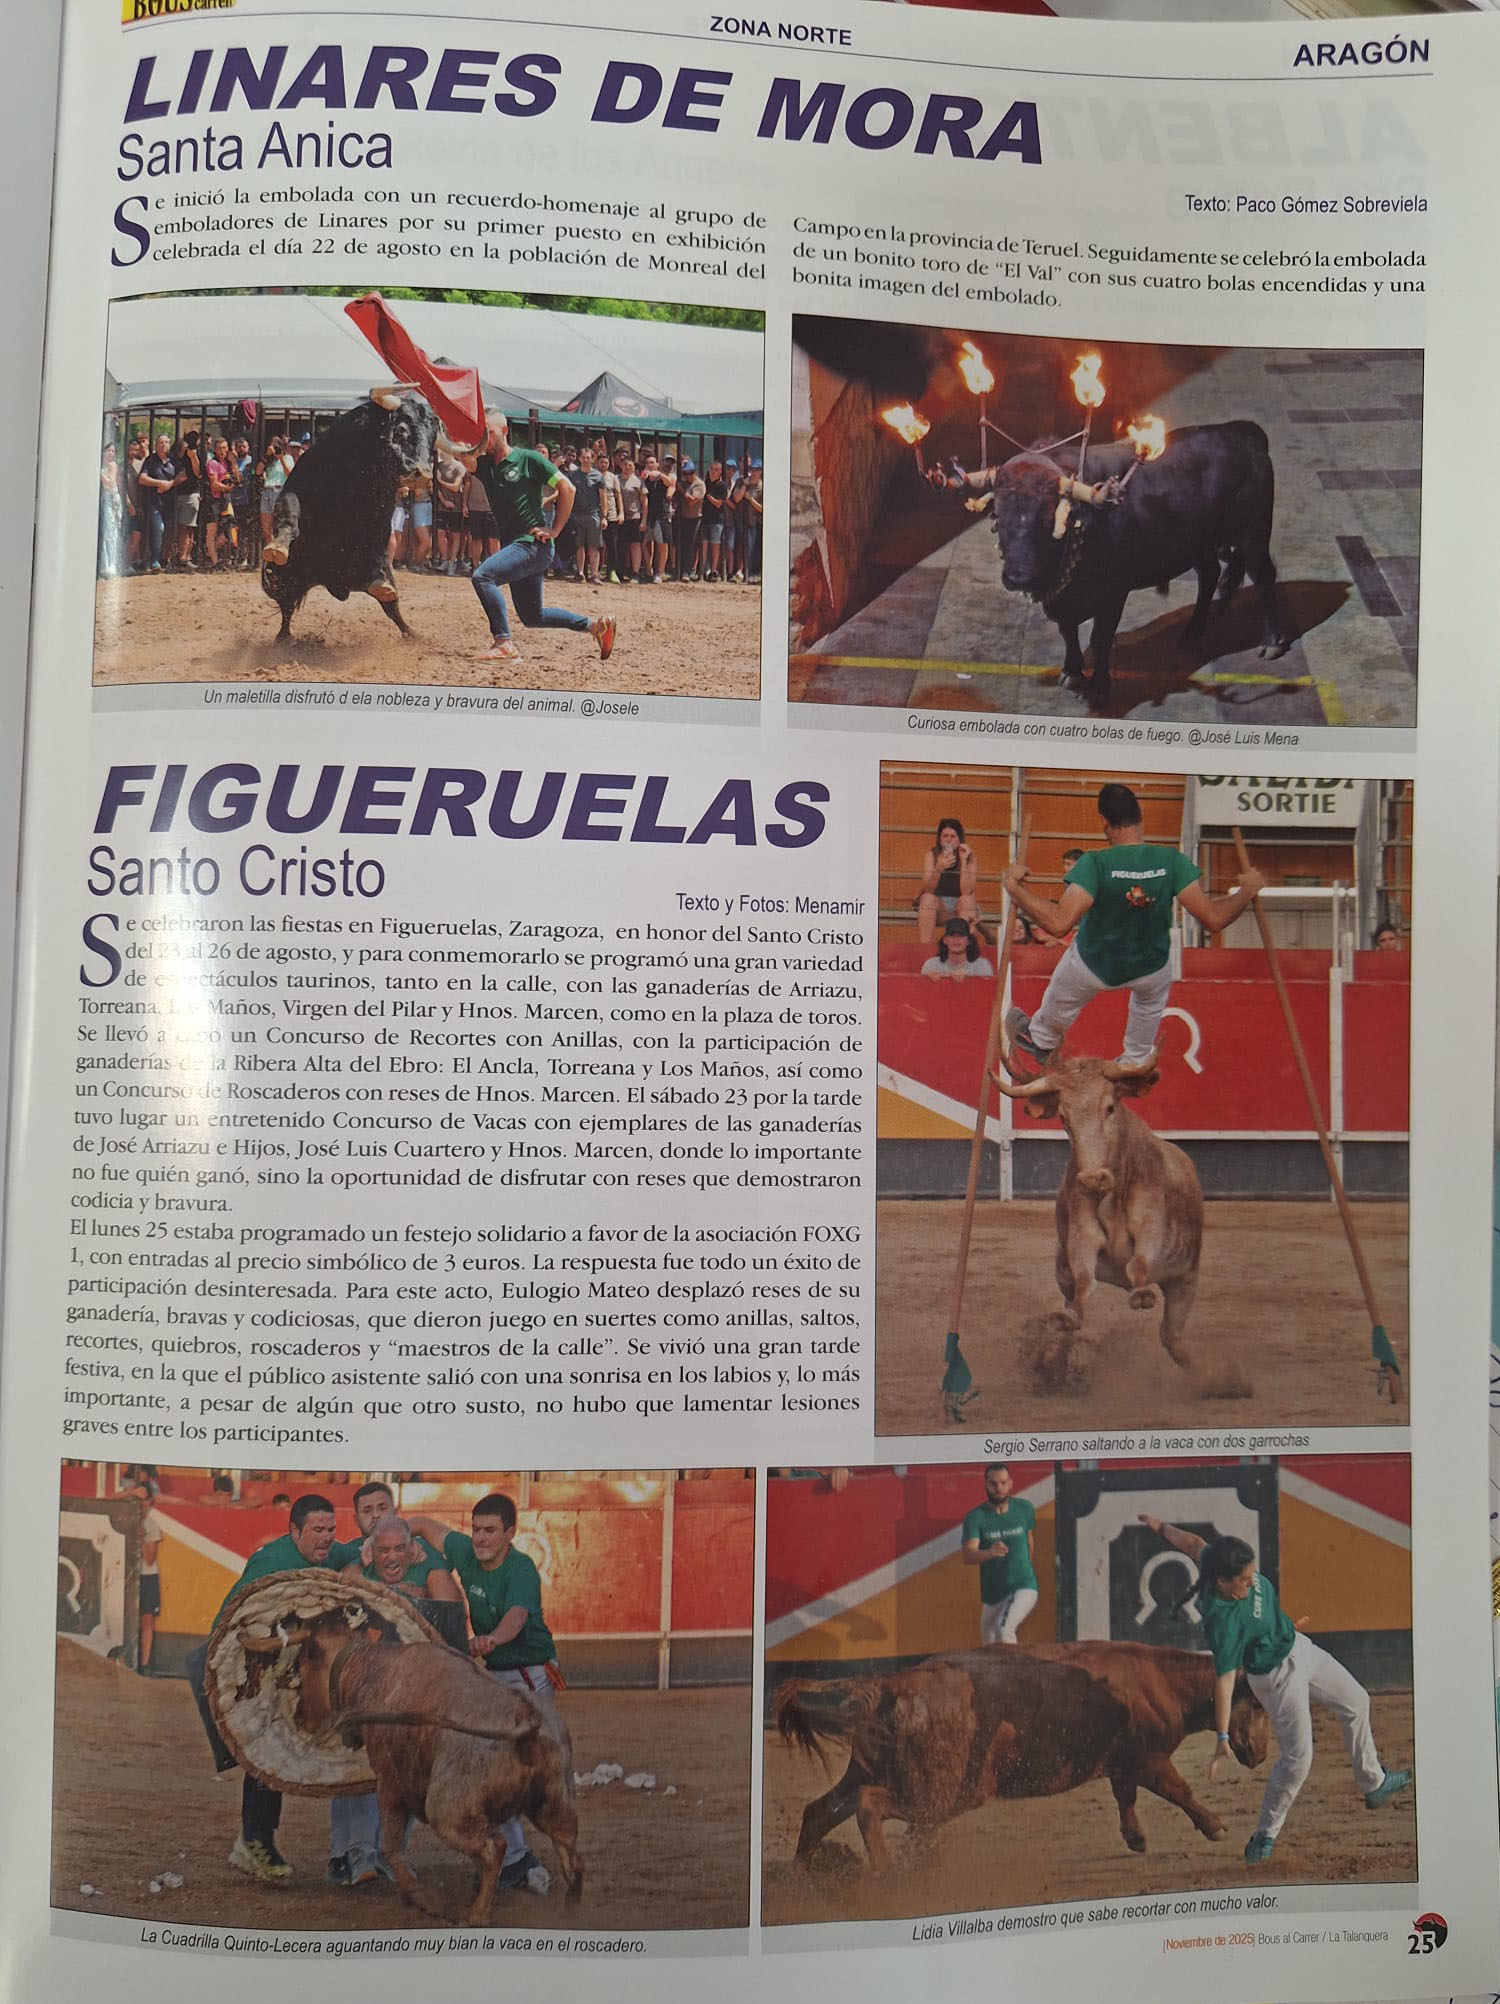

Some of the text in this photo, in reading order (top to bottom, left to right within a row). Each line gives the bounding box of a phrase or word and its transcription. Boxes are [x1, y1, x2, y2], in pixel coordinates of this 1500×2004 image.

[710, 15, 852, 46] ZONA NORTE
[1293, 33, 1430, 67] ARAGÓN
[123, 45, 1042, 165] LINARES DE MORA
[117, 121, 392, 182] Santa Anica
[1184, 194, 1428, 213] Texto: Paco Gómez Sobreviela
[154, 212, 766, 254] emboladores de Linares por su primer puesto en exhibición
[793, 217, 1427, 267] Campo en la provincia de Teruel. Seguidamente se celebró la embolada
[793, 266, 1062, 307] bonita imagen del embolado.
[204, 689, 222, 704] Un
[226, 690, 281, 703] maletilla
[285, 689, 335, 704] disfrutó
[339, 690, 349, 705] d
[352, 691, 372, 705] ela
[376, 691, 430, 707] nobleza
[433, 696, 443, 711] y
[446, 693, 499, 709] bravura
[502, 696, 524, 710] del
[527, 697, 575, 713] animal.
[908, 715, 955, 731] Curiosa
[959, 719, 1020, 734] embolada
[1024, 724, 1046, 736] con
[1050, 725, 1088, 738] cuatro
[1091, 725, 1124, 739] bolas
[1128, 727, 1143, 740] de
[1146, 727, 1184, 745] fuego.
[1234, 731, 1260, 744] Luis
[1264, 732, 1299, 746] Mena
[93, 763, 830, 848] FIGUERUELAS
[1236, 791, 1336, 814] SORTIE
[87, 843, 385, 898] Santo Cristo
[675, 892, 866, 916] Texto y Fotos: Menamir
[70, 1191, 232, 1214] codicia y bravura.
[69, 1218, 862, 1247] El lunes 25 estaba programado un festejo solidario a favor de la asociación FOXG
[66, 1335, 143, 1354] recortes,
[151, 1336, 241, 1358] quiebros,
[250, 1338, 361, 1357] roscaderos
[368, 1344, 381, 1362] y
[498, 1338, 524, 1356] de
[532, 1338, 550, 1356] la
[627, 1338, 651, 1355] Se
[658, 1337, 705, 1355] vivió
[713, 1342, 751, 1355] una
[758, 1342, 803, 1359] gran
[810, 1336, 861, 1354] tarde
[62, 1418, 349, 1447] graves entre los participantes.
[984, 1435, 1309, 1456] Sergio Serrano saltando a la vaca con dos garrochas
[912, 1894, 1279, 1941] Lidia Villalba demostro que sabe recortar con mucho valor.
[140, 1927, 646, 1957] La Cuadrilla Quinto-Lecera aguantando muy bian la vaca en el roscadero.
[1214, 1935, 1226, 1946] de
[1258, 1933, 1281, 1945] Bous
[1283, 1932, 1291, 1944] al
[1293, 1931, 1320, 1943] Carrer
[1329, 1931, 1340, 1942] La
[1342, 1930, 1389, 1943] Talanquera
[1407, 1933, 1434, 1955] 25
